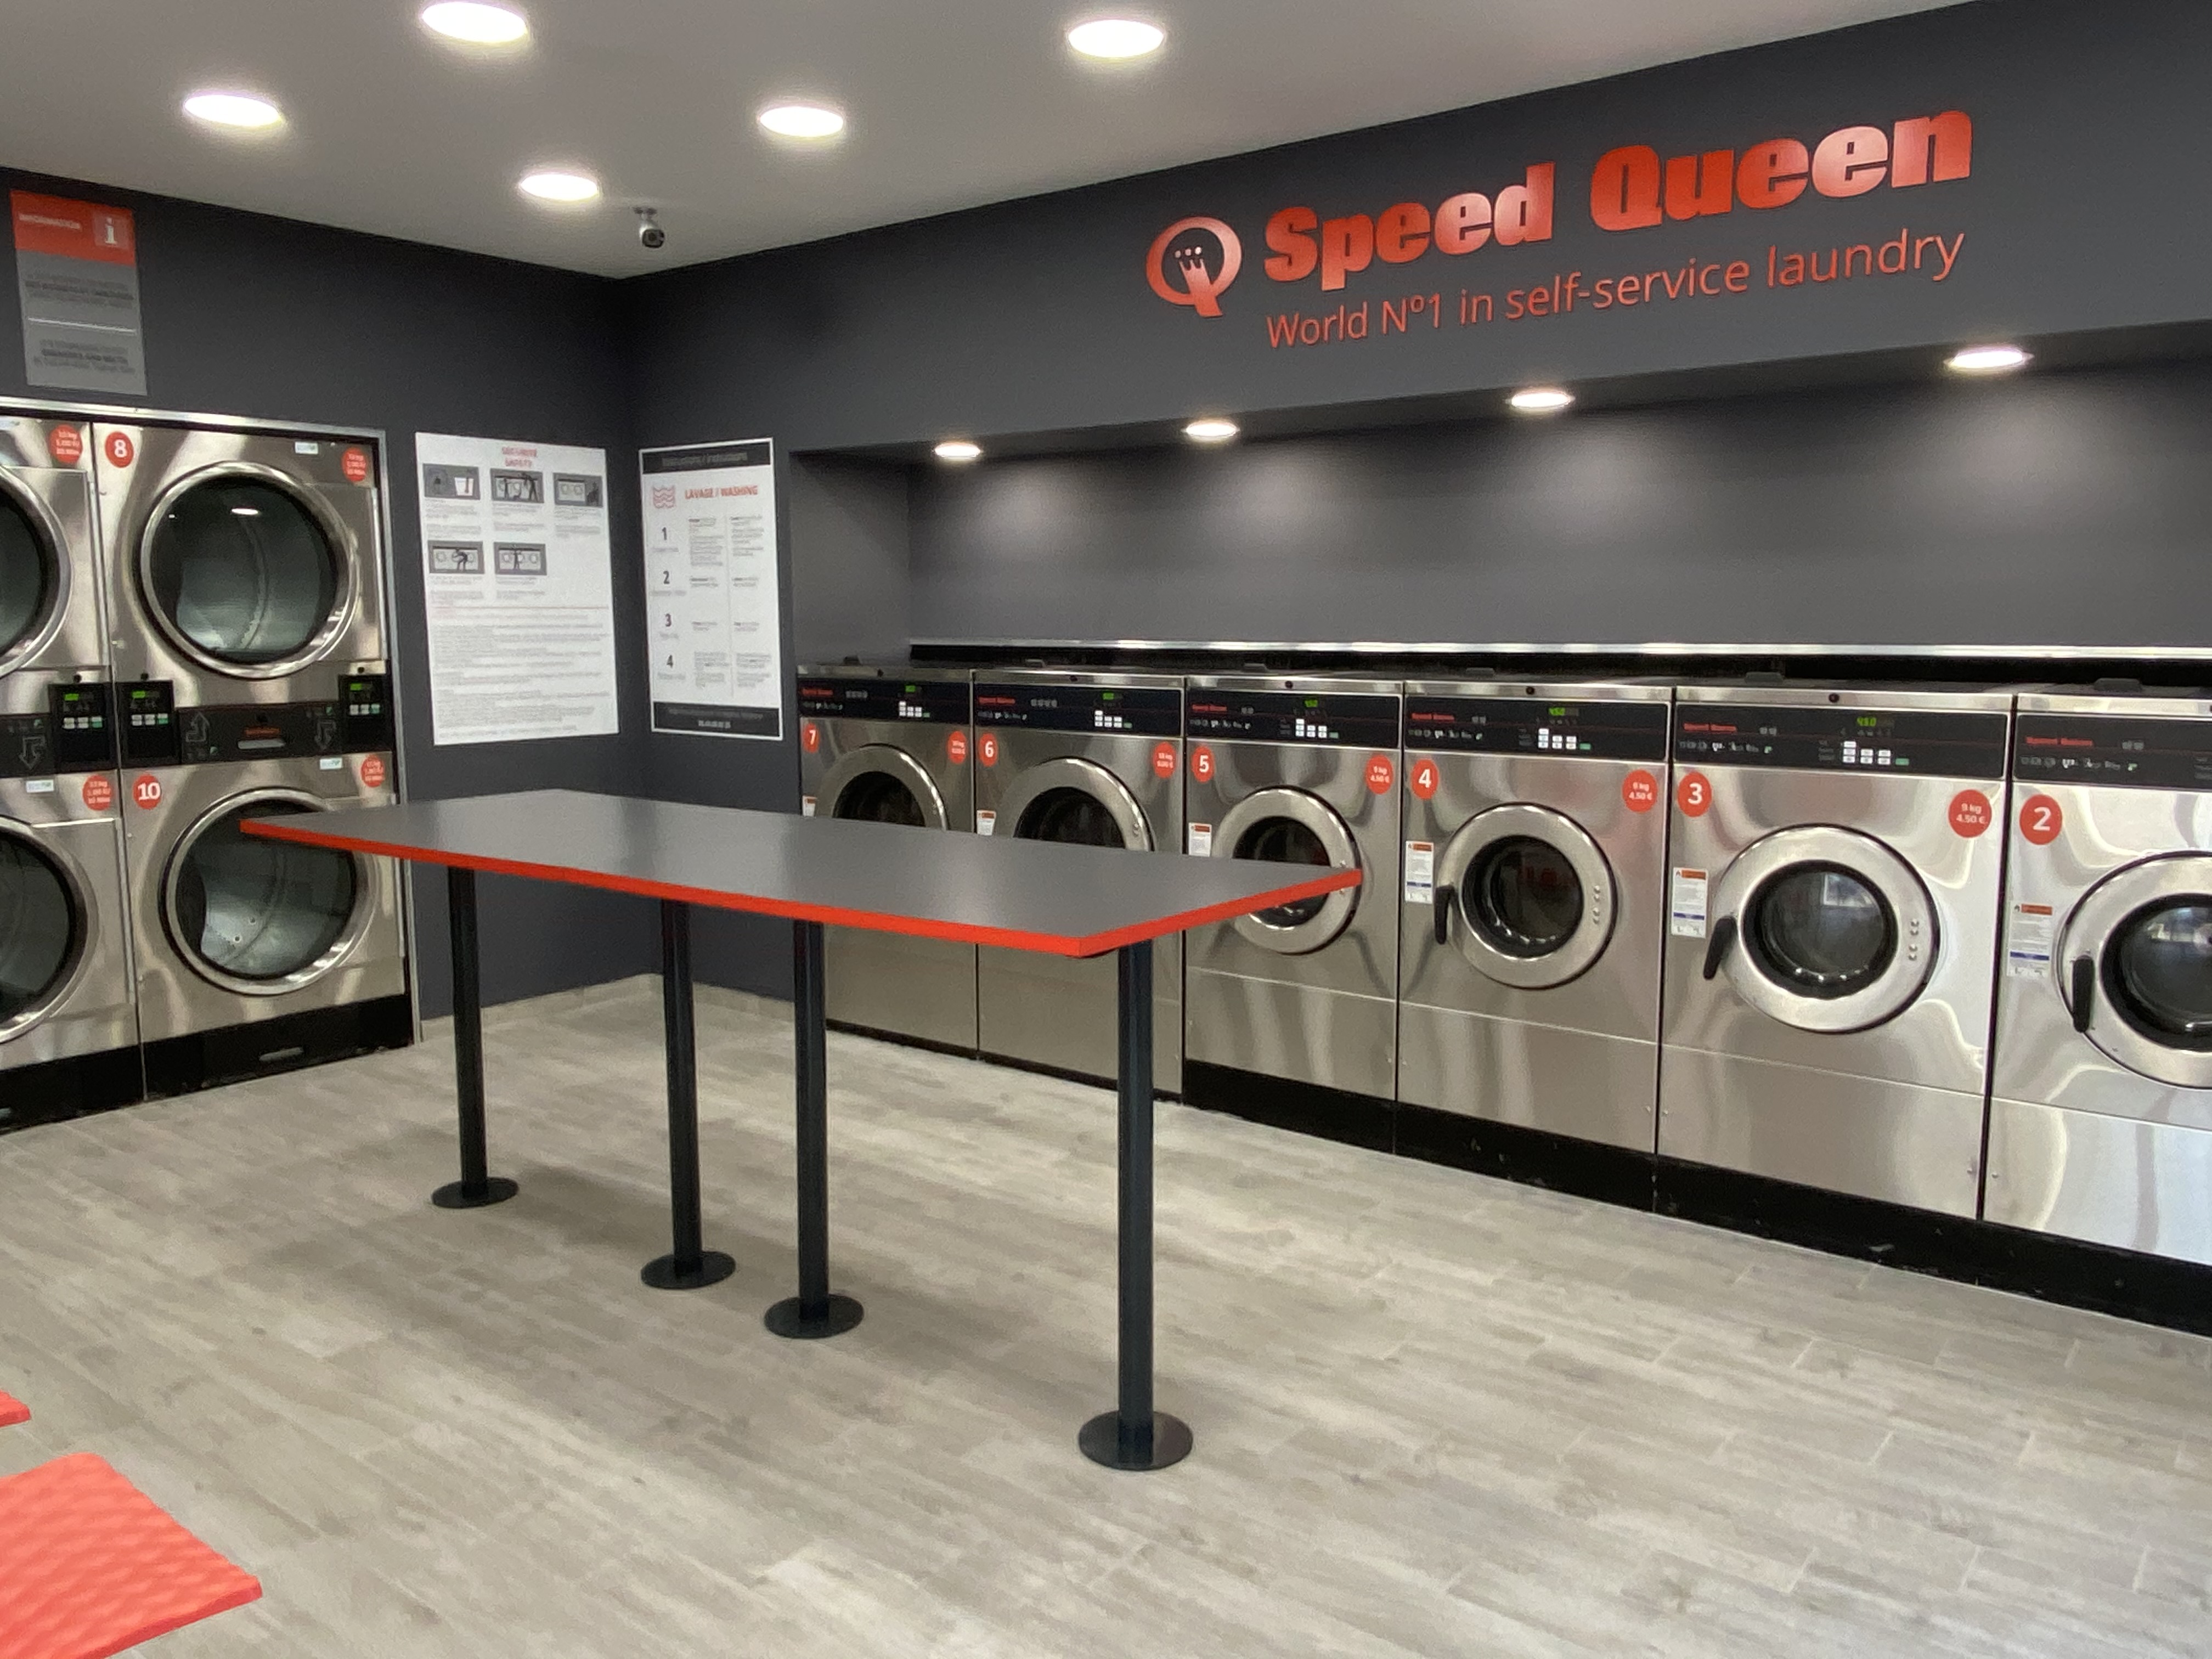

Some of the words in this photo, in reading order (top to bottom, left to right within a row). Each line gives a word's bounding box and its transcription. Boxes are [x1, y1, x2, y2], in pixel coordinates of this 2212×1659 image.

[1264, 162, 1555, 290] Speed
[1590, 110, 1973, 232] Queen
[1267, 301, 1368, 348] World
[1459, 289, 1493, 325] in
[1505, 258, 1750, 320] self-service
[1767, 228, 1965, 289] laundry
[114, 439, 127, 458] 8
[685, 488, 713, 499] LAVAGE
[662, 527, 667, 540] 1
[663, 571, 670, 584] 2
[665, 613, 672, 627] 3
[667, 654, 674, 669] 4
[809, 730, 816, 745] 7
[985, 741, 994, 758] 6
[1199, 755, 1209, 772] 5
[1418, 769, 1432, 788] 4
[137, 782, 161, 801] 10
[1688, 783, 1703, 805] 3
[1969, 804, 1982, 815] kg
[2033, 806, 2052, 831] 2
